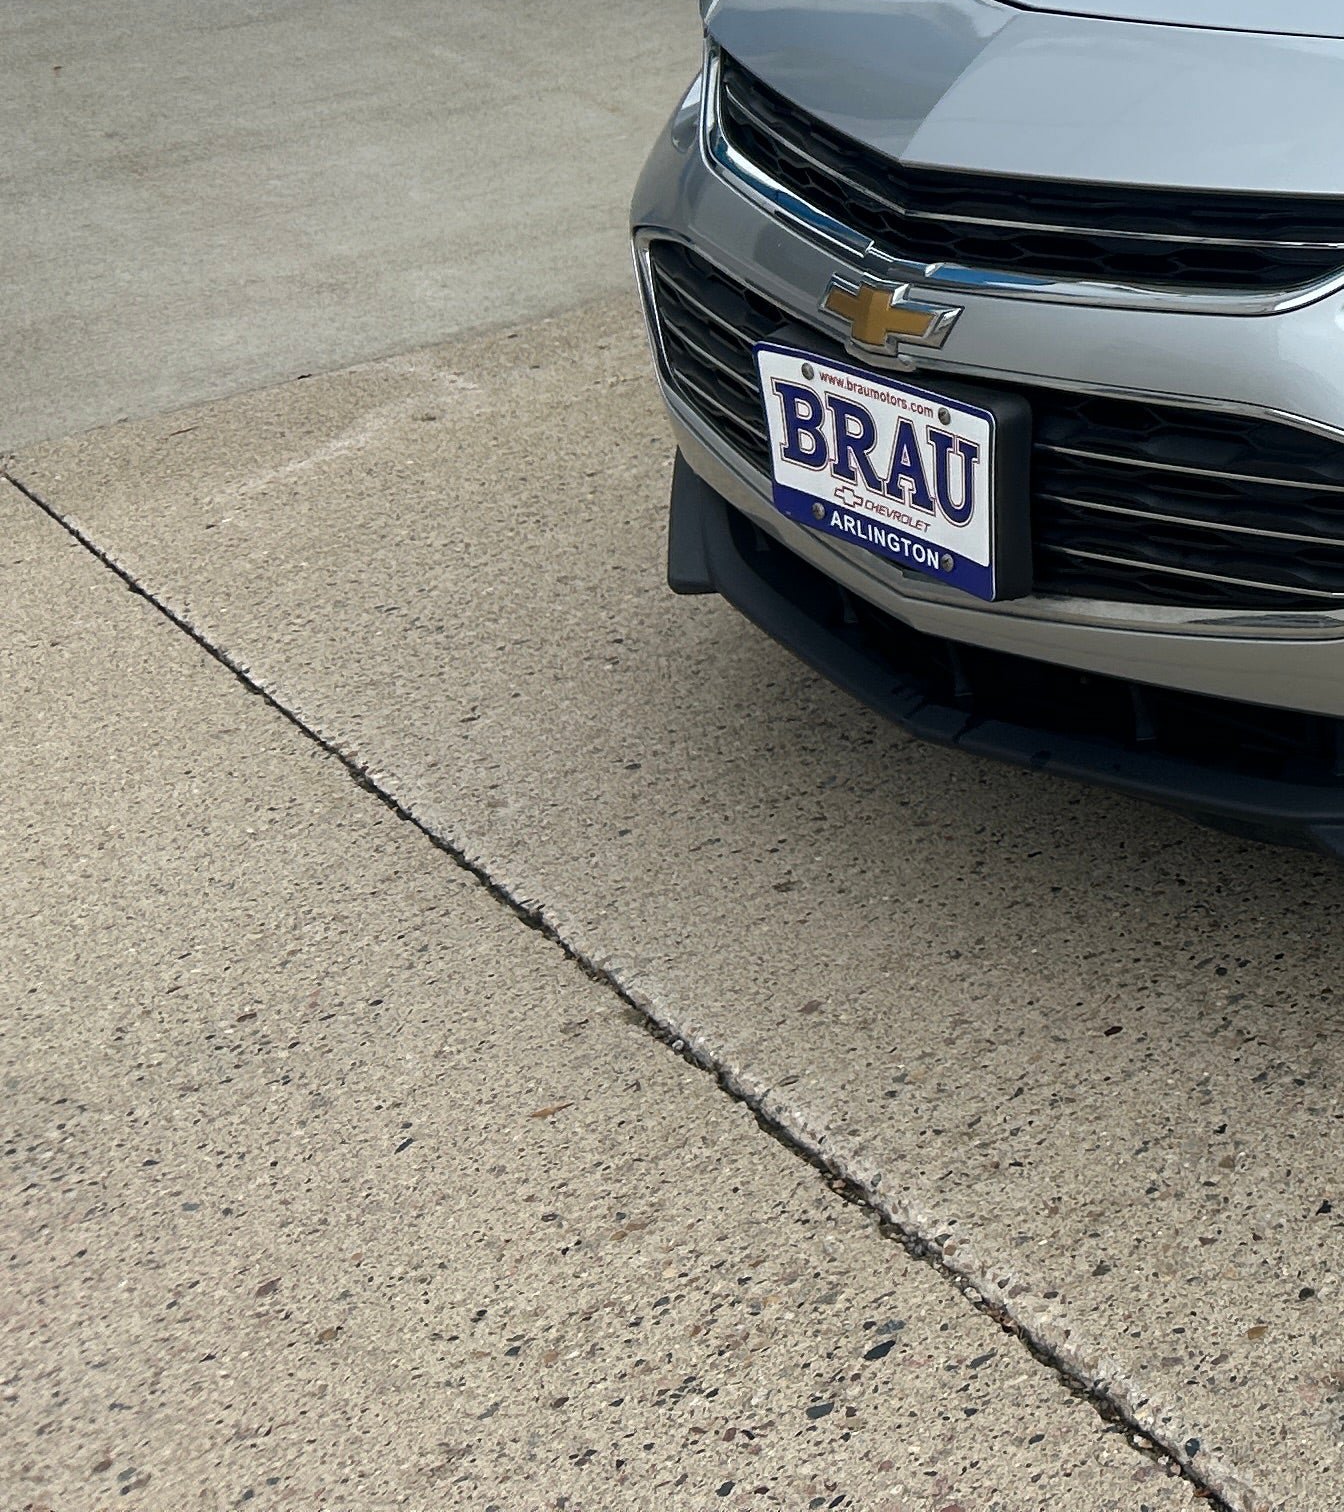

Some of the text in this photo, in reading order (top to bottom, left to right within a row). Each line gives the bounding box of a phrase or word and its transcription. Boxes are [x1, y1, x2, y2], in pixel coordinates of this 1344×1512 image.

[818, 370, 935, 419] www.braumotors.com
[770, 376, 981, 528] BRAU
[830, 510, 940, 571] ARLINGTON
[863, 499, 931, 533] CHEVROLET
